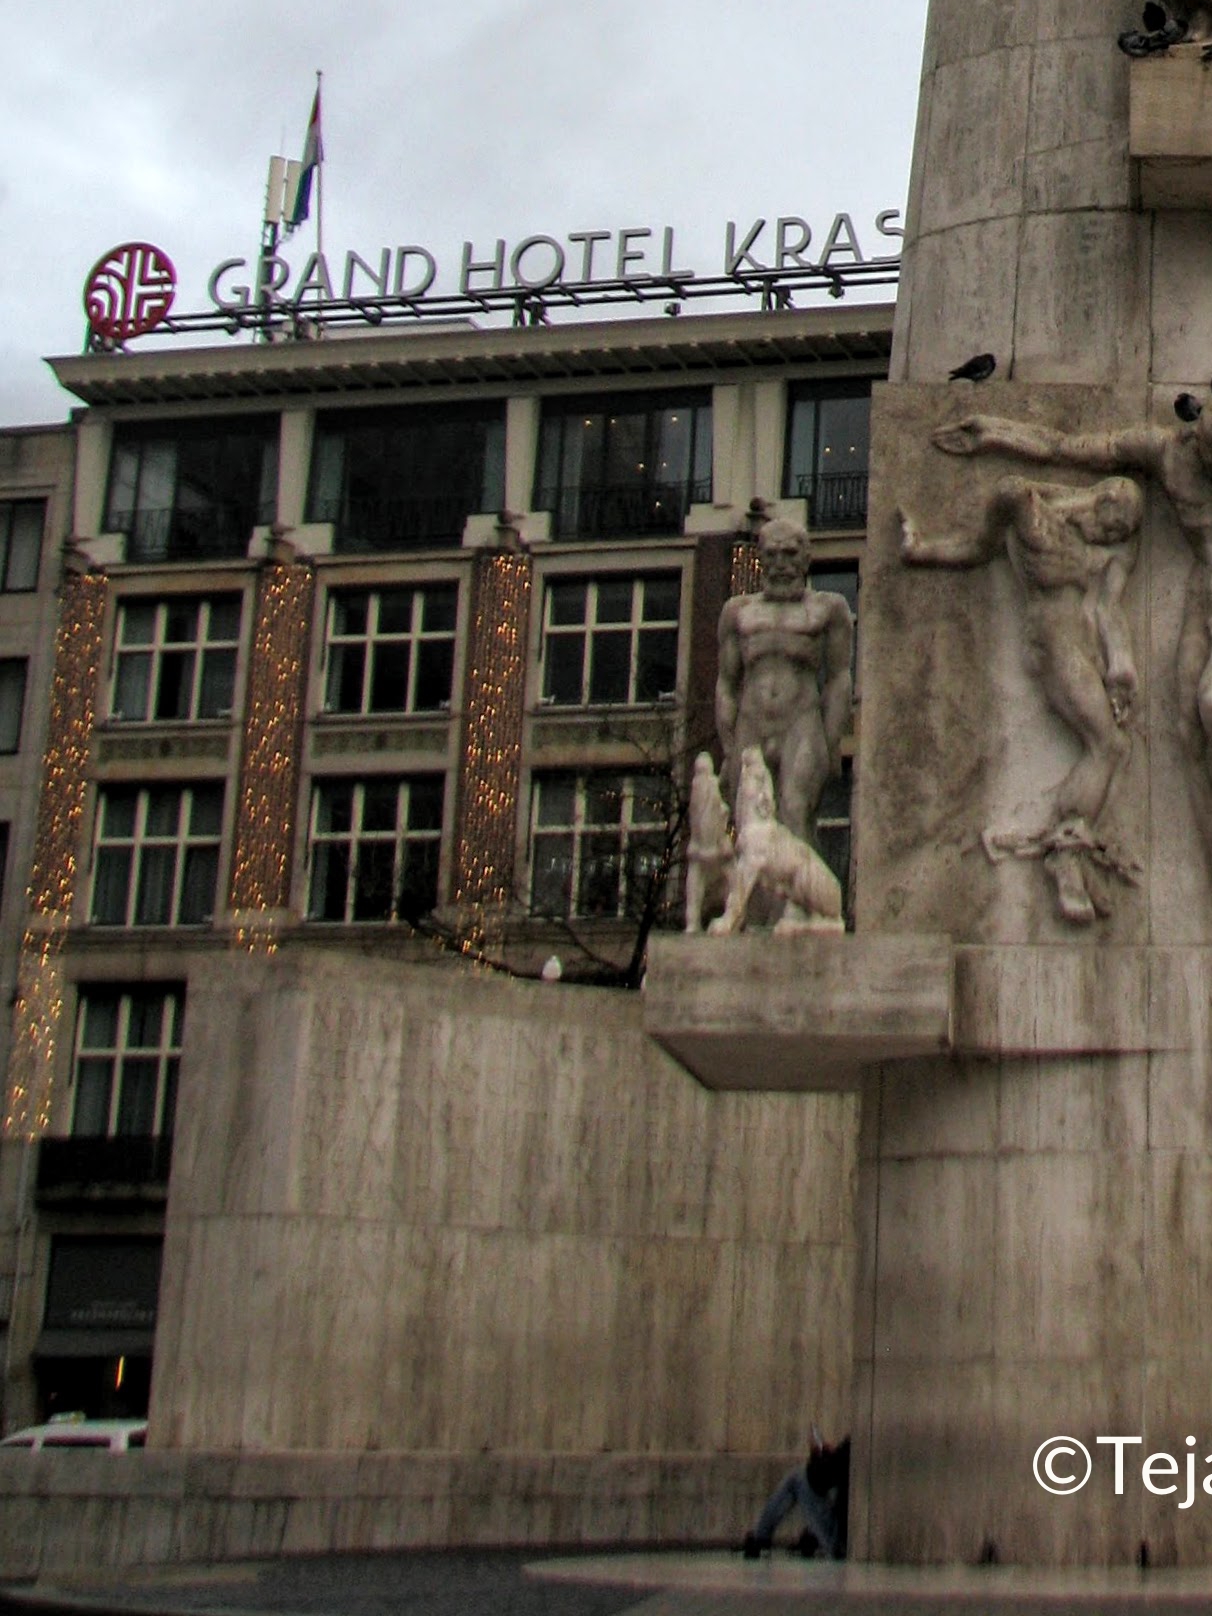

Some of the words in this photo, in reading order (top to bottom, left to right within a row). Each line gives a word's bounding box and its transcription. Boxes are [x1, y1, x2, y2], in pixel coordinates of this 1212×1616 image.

[208, 245, 437, 310] GRAND
[459, 226, 695, 294] HOTEL
[724, 209, 906, 275] KRAS
